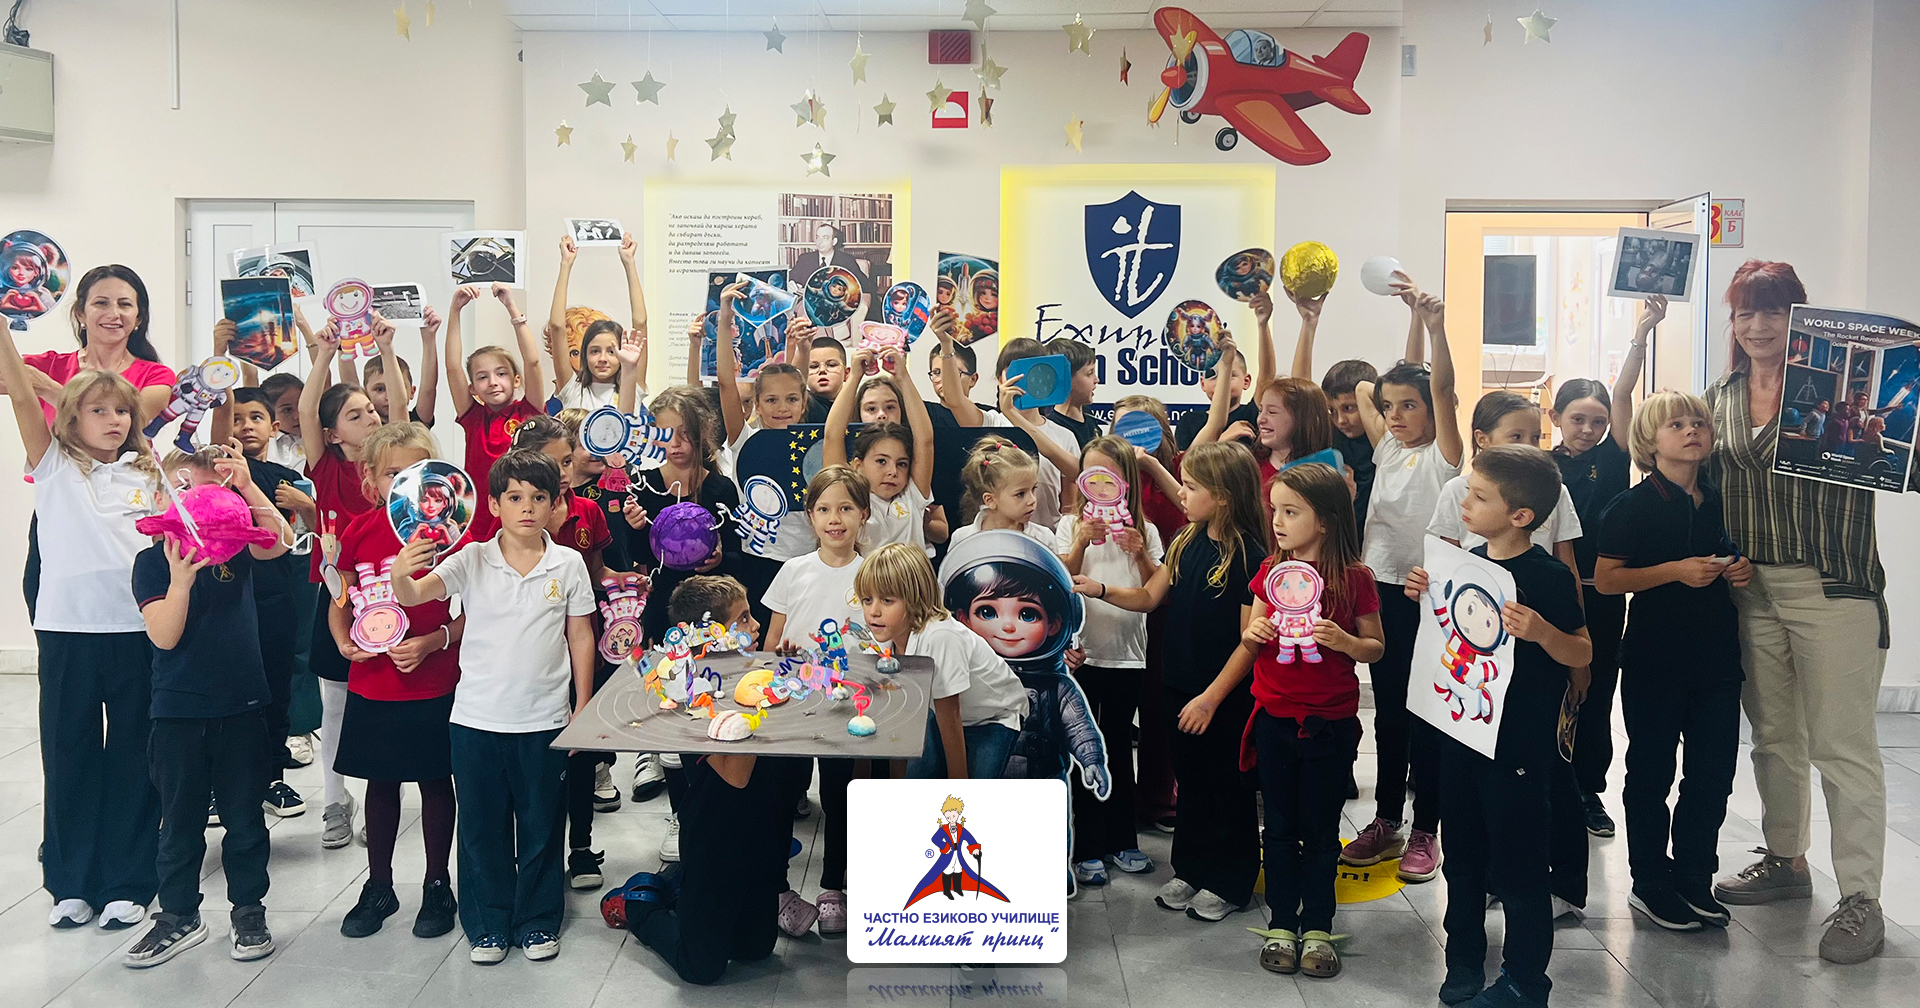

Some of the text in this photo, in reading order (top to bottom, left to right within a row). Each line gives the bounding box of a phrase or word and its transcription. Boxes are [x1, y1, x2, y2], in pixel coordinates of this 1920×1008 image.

[1035, 303, 1228, 359] Exup
[1803, 318, 1920, 339] WORLD SPACE WEEK
[1836, 333, 1859, 341] Rocket
[1860, 335, 1895, 344] Revolution
